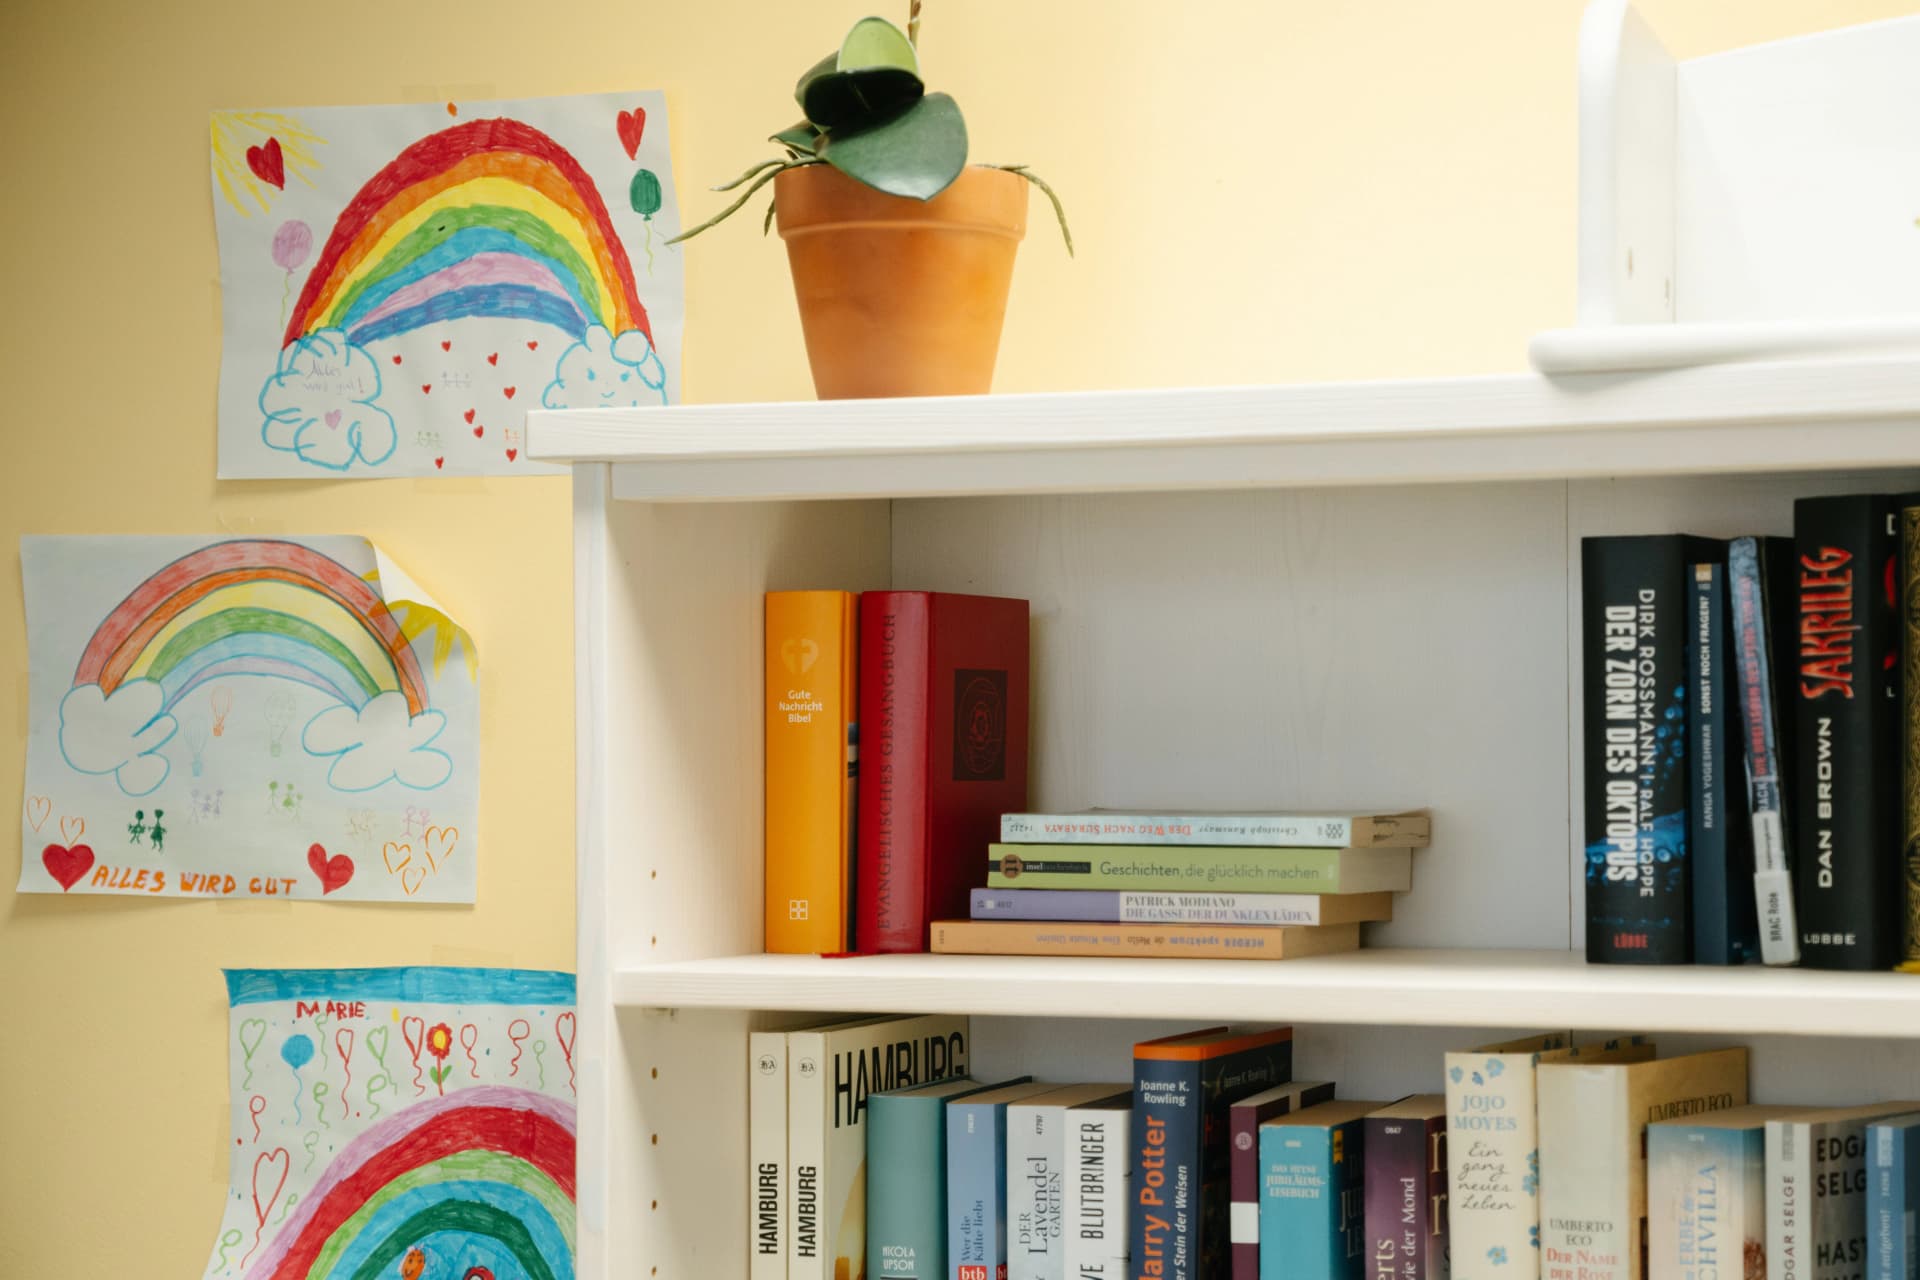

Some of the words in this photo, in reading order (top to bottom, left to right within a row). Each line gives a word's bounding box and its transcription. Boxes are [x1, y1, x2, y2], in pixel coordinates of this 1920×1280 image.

[1638, 588, 1655, 639] DIRK
[1700, 594, 1710, 632] FRAGEN?
[1605, 605, 1636, 654] DER
[1701, 634, 1711, 671] NOCH
[788, 690, 811, 701] Gute
[881, 614, 897, 757] GESANGBUCH
[1605, 659, 1636, 720] ZORN
[1638, 646, 1656, 755] ROSSMANN
[1701, 673, 1712, 715] SONST
[779, 701, 823, 712] Nachricht
[788, 713, 812, 723] Bibel
[1605, 726, 1636, 771] DES
[1701, 724, 1712, 788] YOGESHWAR
[1818, 717, 1833, 820] BROWN
[1638, 790, 1654, 833] RALF
[1703, 791, 1713, 829] RANGA
[1755, 783, 1769, 812] RACK
[1044, 822, 1101, 835] SURABAYA
[1104, 822, 1135, 835] NACH
[1138, 822, 1165, 836] WEG
[1168, 822, 1192, 836] DER
[1605, 779, 1638, 882] OKTOPUS
[877, 764, 894, 929] EVANGELISCHES
[1818, 831, 1834, 889] DAN
[91, 865, 168, 893] ALLES
[179, 871, 237, 895] WIRD
[1100, 860, 1184, 879] Geschichten,
[1185, 861, 1204, 877] die
[1207, 861, 1264, 881] glücklich
[1267, 864, 1320, 879] machen
[1639, 837, 1655, 897] HOPPE
[1125, 895, 1176, 908] PATRICK
[1178, 896, 1236, 909] MODIANO
[1125, 908, 1148, 919] DIE
[1149, 908, 1185, 920] GASSE
[1187, 908, 1211, 920] DER
[1213, 909, 1271, 920] DUNKLEN
[296, 999, 367, 1021] MARIE
[834, 1031, 965, 1129] HAMBURG
[1140, 1080, 1176, 1092] Joanne
[1179, 1080, 1190, 1092] K.
[1144, 1092, 1187, 1106] Rowling
[1461, 1096, 1505, 1112] JOJO
[1454, 1115, 1517, 1132] MOYES
[1140, 1116, 1166, 1207] Potter
[1467, 1142, 1503, 1158] Ein
[1080, 1123, 1105, 1240] BLUTBRINGER
[1457, 1160, 1511, 1180] ganz
[1817, 1170, 1867, 1198] SELG
[1175, 1165, 1188, 1209] Weisen
[1400, 1177, 1416, 1224] Mond
[1458, 1181, 1513, 1194] neues
[1783, 1175, 1794, 1227] SELGE
[759, 1163, 778, 1255] HAMBURG
[798, 1165, 817, 1258] HAMBURG
[973, 1200, 984, 1228] liebt
[1028, 1156, 1048, 1256] Lavendel
[1049, 1171, 1061, 1238] GARTEN
[1460, 1194, 1516, 1212] Leben
[960, 1215, 971, 1230] die
[1019, 1212, 1031, 1245] DER
[1175, 1212, 1188, 1232] der
[1549, 1219, 1614, 1233] UMBERTO
[1698, 1165, 1717, 1280] CHVILLA
[882, 1246, 916, 1257] NICOLA
[960, 1232, 972, 1263] Wer
[1174, 1235, 1187, 1267] Stein
[1400, 1230, 1416, 1256] der
[1565, 1235, 1593, 1247] ECO
[1680, 1217, 1694, 1265] ERBE
[1817, 1238, 1868, 1267] HAS
[883, 1258, 915, 1271] UPSON
[1376, 1238, 1395, 1280] erts
[1546, 1249, 1574, 1265] DER
[1576, 1249, 1619, 1266] NAME
[1783, 1235, 1795, 1280] DGAR
[961, 1267, 985, 1280] btb
[1175, 1270, 1187, 1280] er
